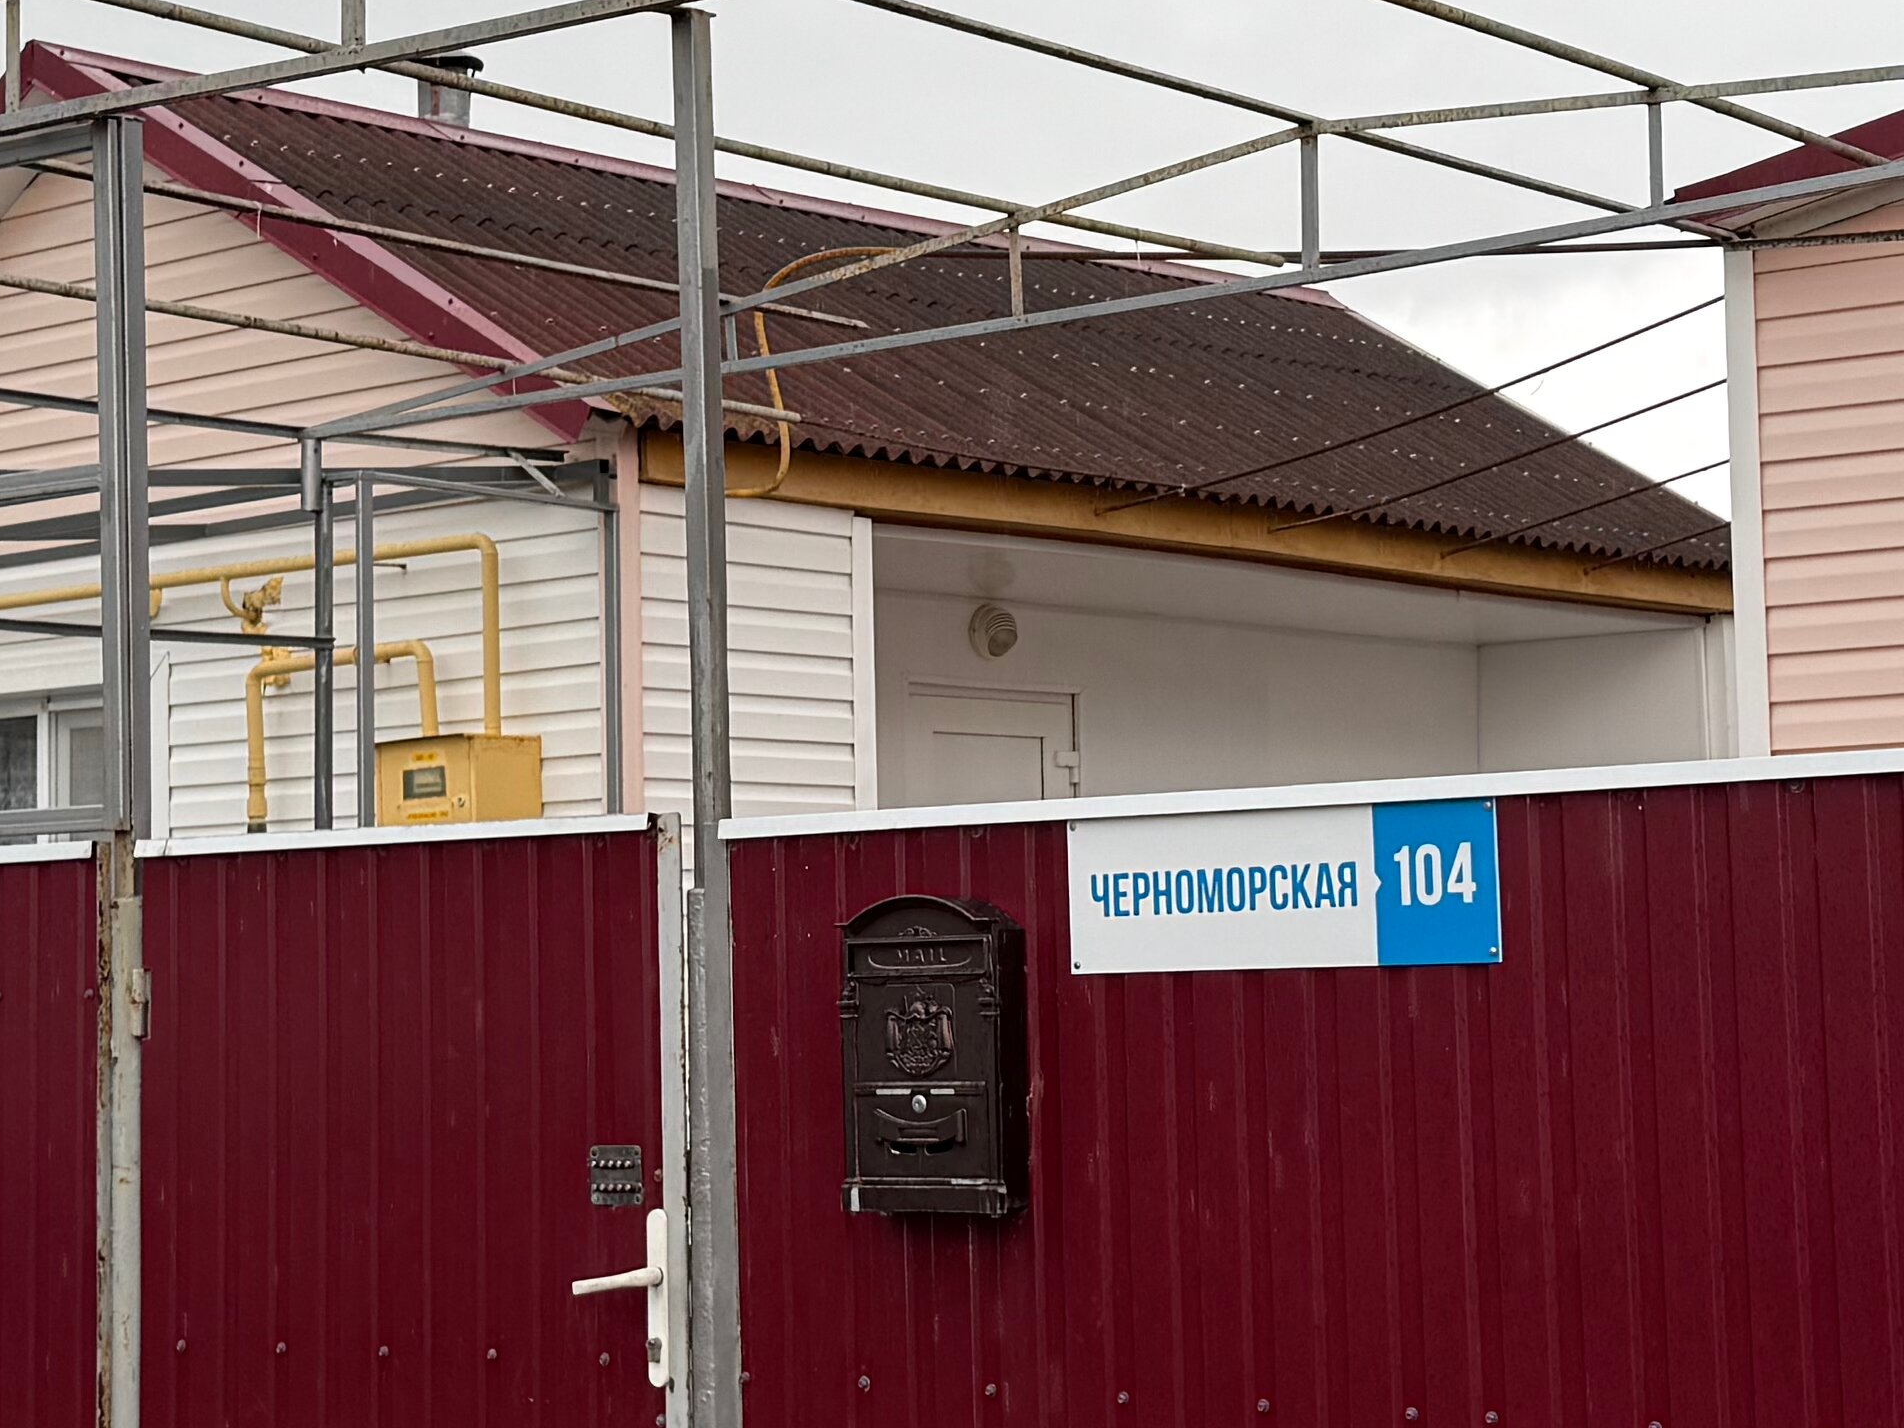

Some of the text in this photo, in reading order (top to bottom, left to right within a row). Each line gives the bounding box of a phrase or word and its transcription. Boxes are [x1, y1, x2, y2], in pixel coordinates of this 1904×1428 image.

[1089, 841, 1478, 918] ЧЕРНОМОРСКАЯ 104
[895, 947, 947, 963] MAIL
